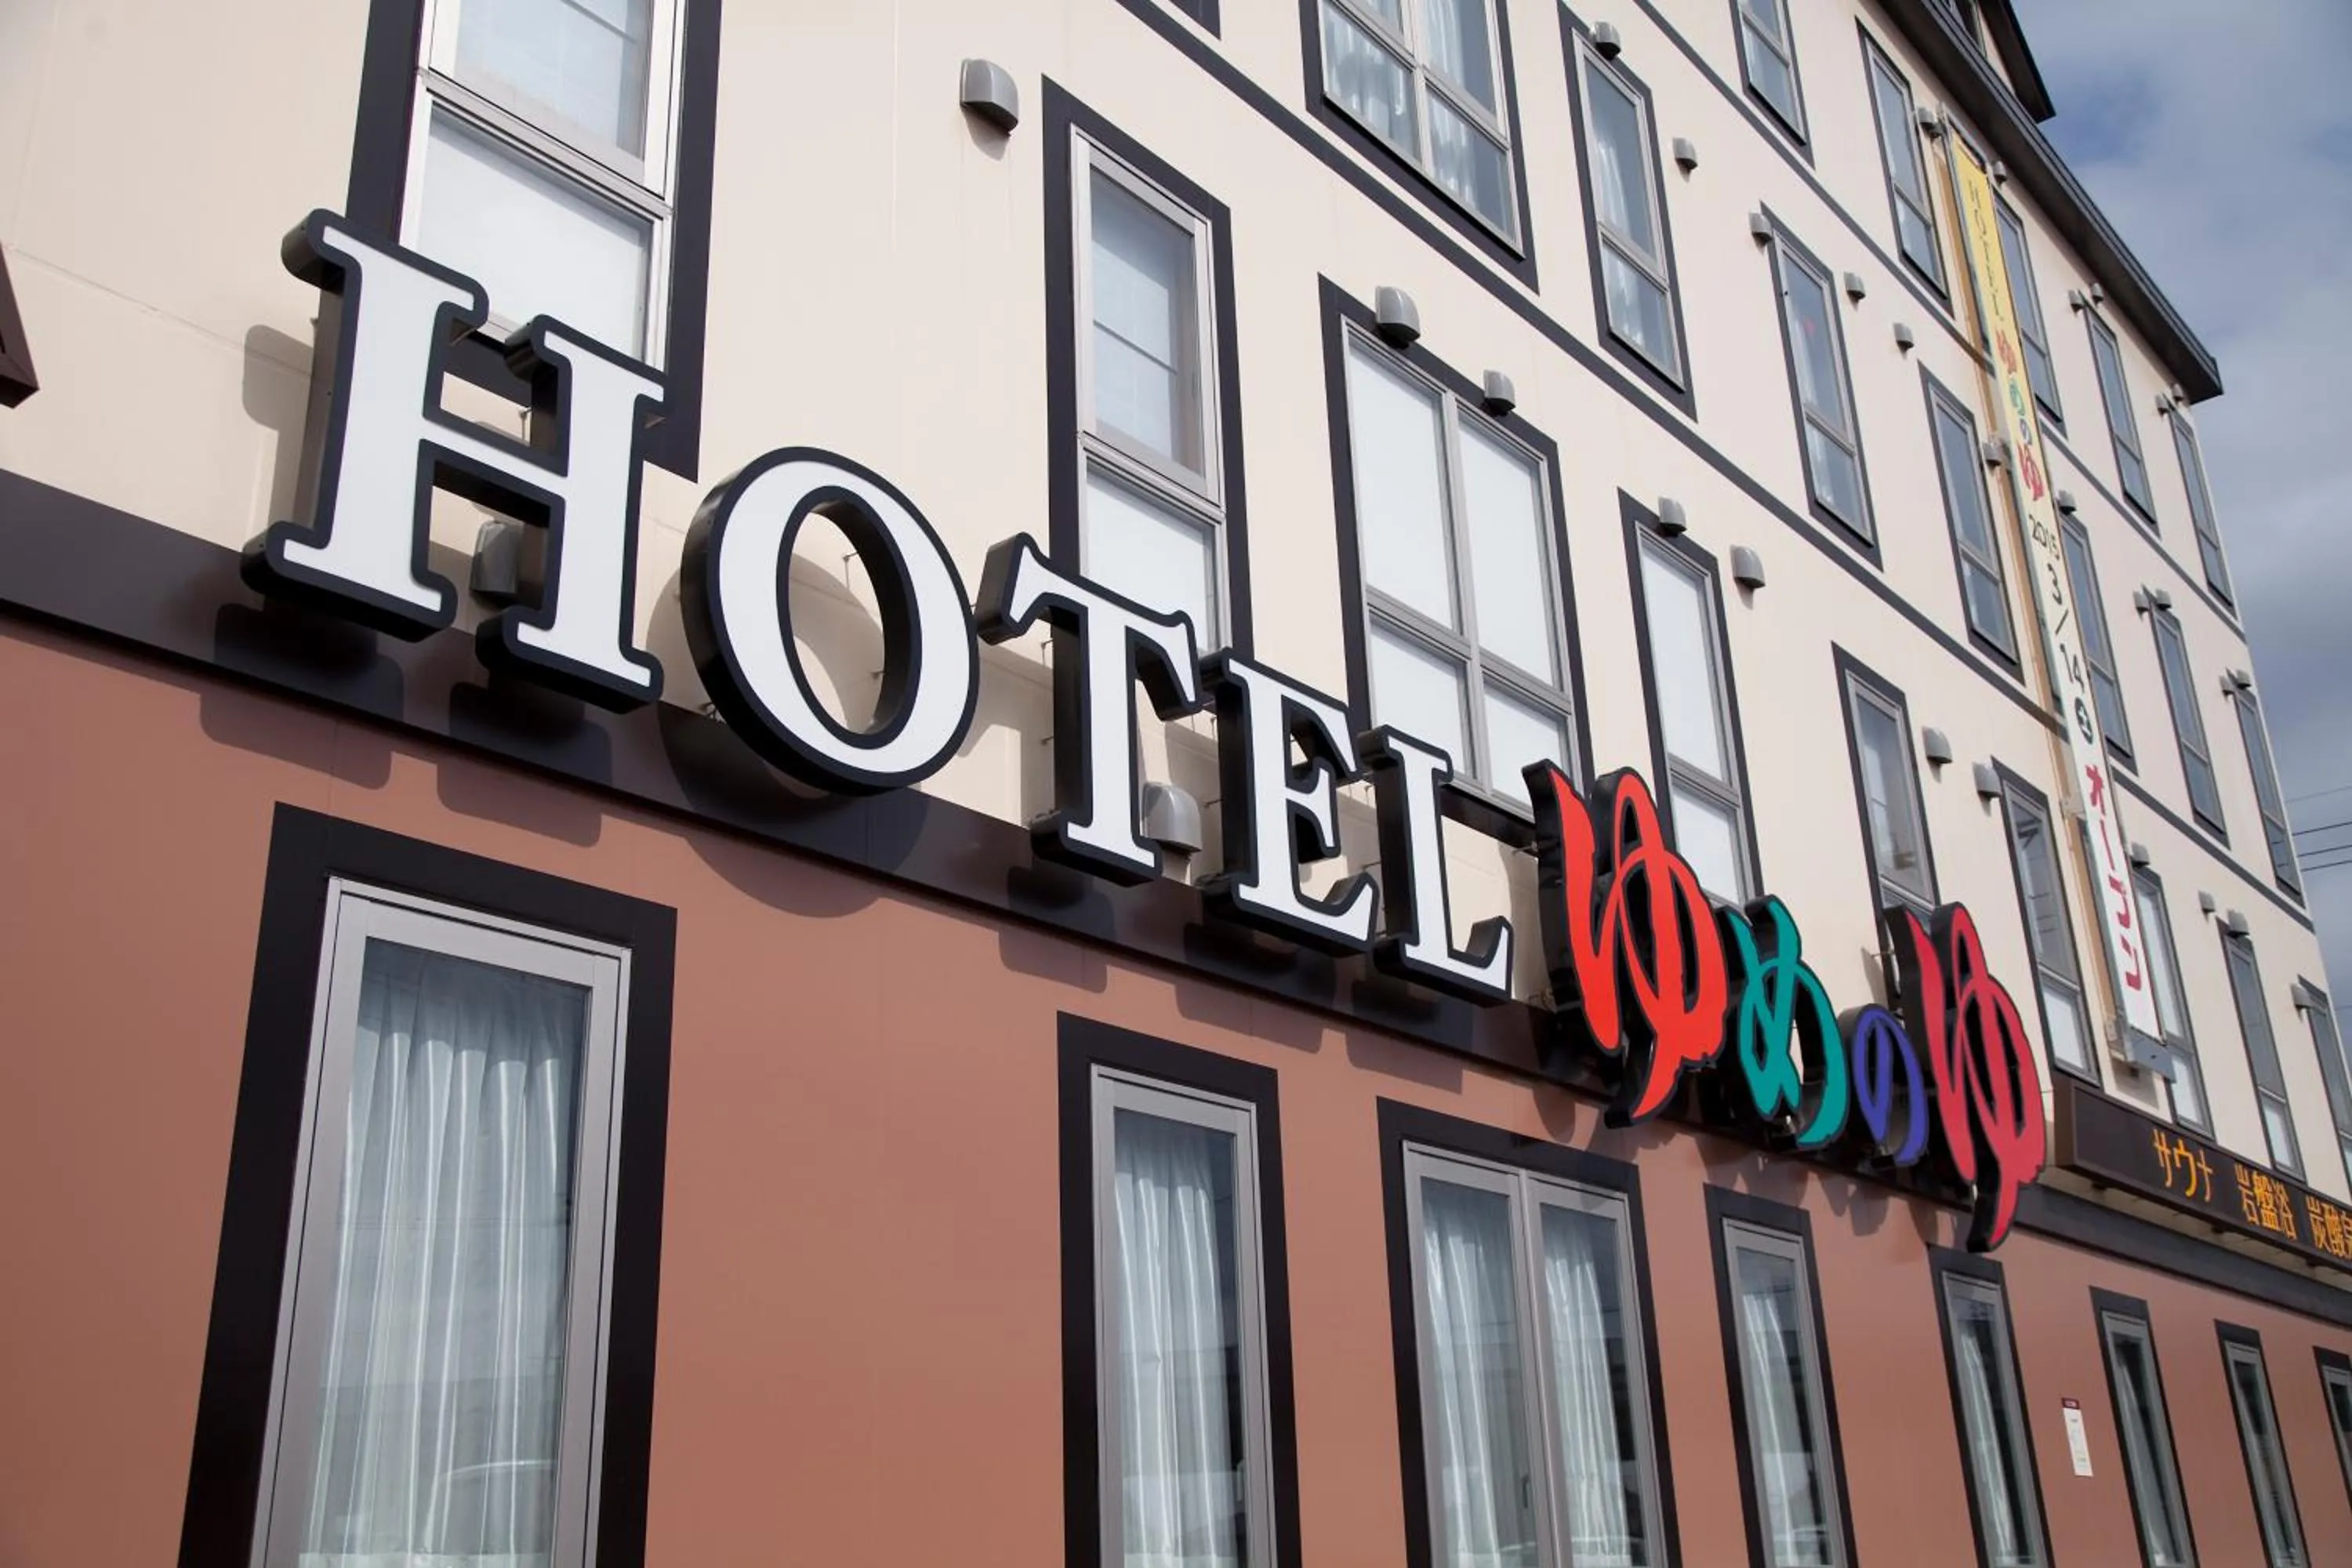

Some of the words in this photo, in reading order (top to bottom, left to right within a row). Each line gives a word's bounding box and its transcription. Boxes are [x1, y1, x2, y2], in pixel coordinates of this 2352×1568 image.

[1996, 328, 2045, 502] ゆめのゆ
[263, 208, 1514, 1002] HOTEL
[1533, 764, 2048, 1250] ゆめのゆ
[2154, 1128, 2213, 1203] サウナ
[2235, 1163, 2297, 1240] 岩盤浴
